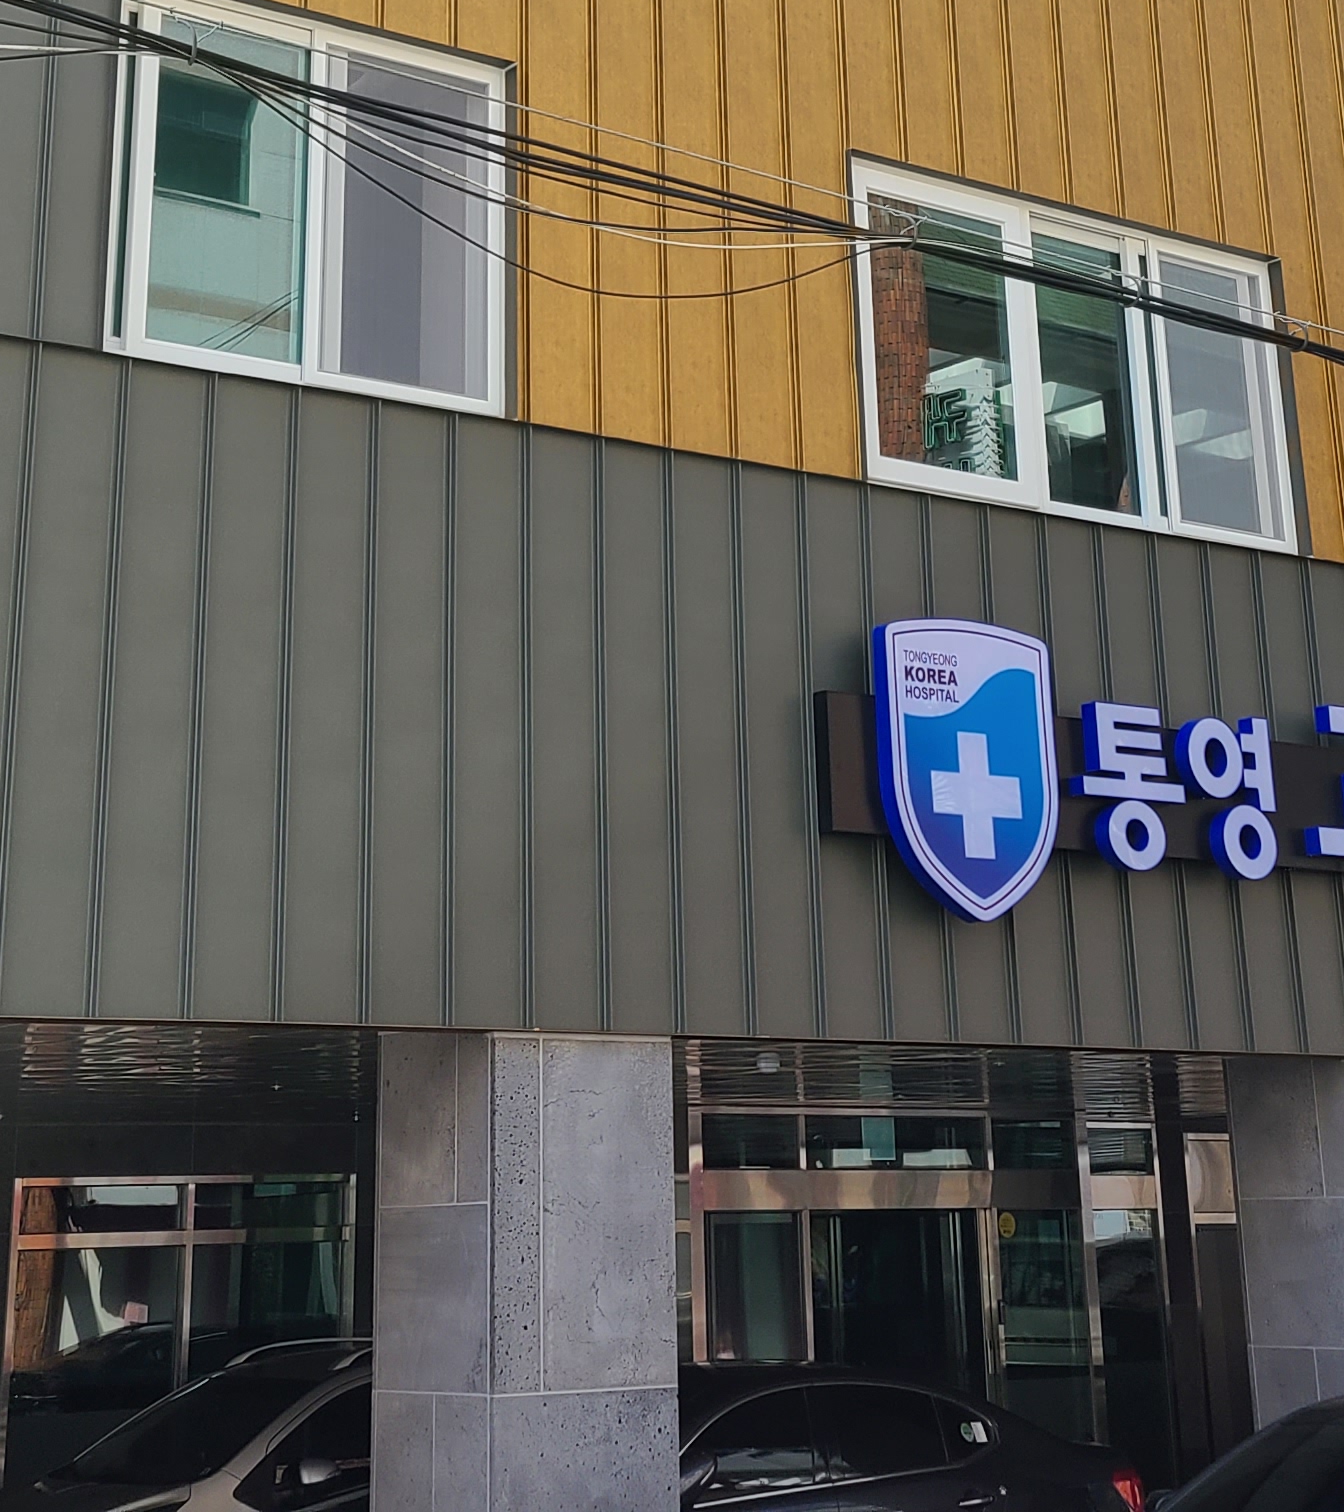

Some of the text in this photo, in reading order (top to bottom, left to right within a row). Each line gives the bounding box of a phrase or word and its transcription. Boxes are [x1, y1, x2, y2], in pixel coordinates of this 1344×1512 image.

[903, 649, 958, 666] TONGYEONG
[904, 665, 958, 687] KOREA
[904, 684, 960, 703] HOSPITAL
[1068, 700, 1279, 881] 통영
